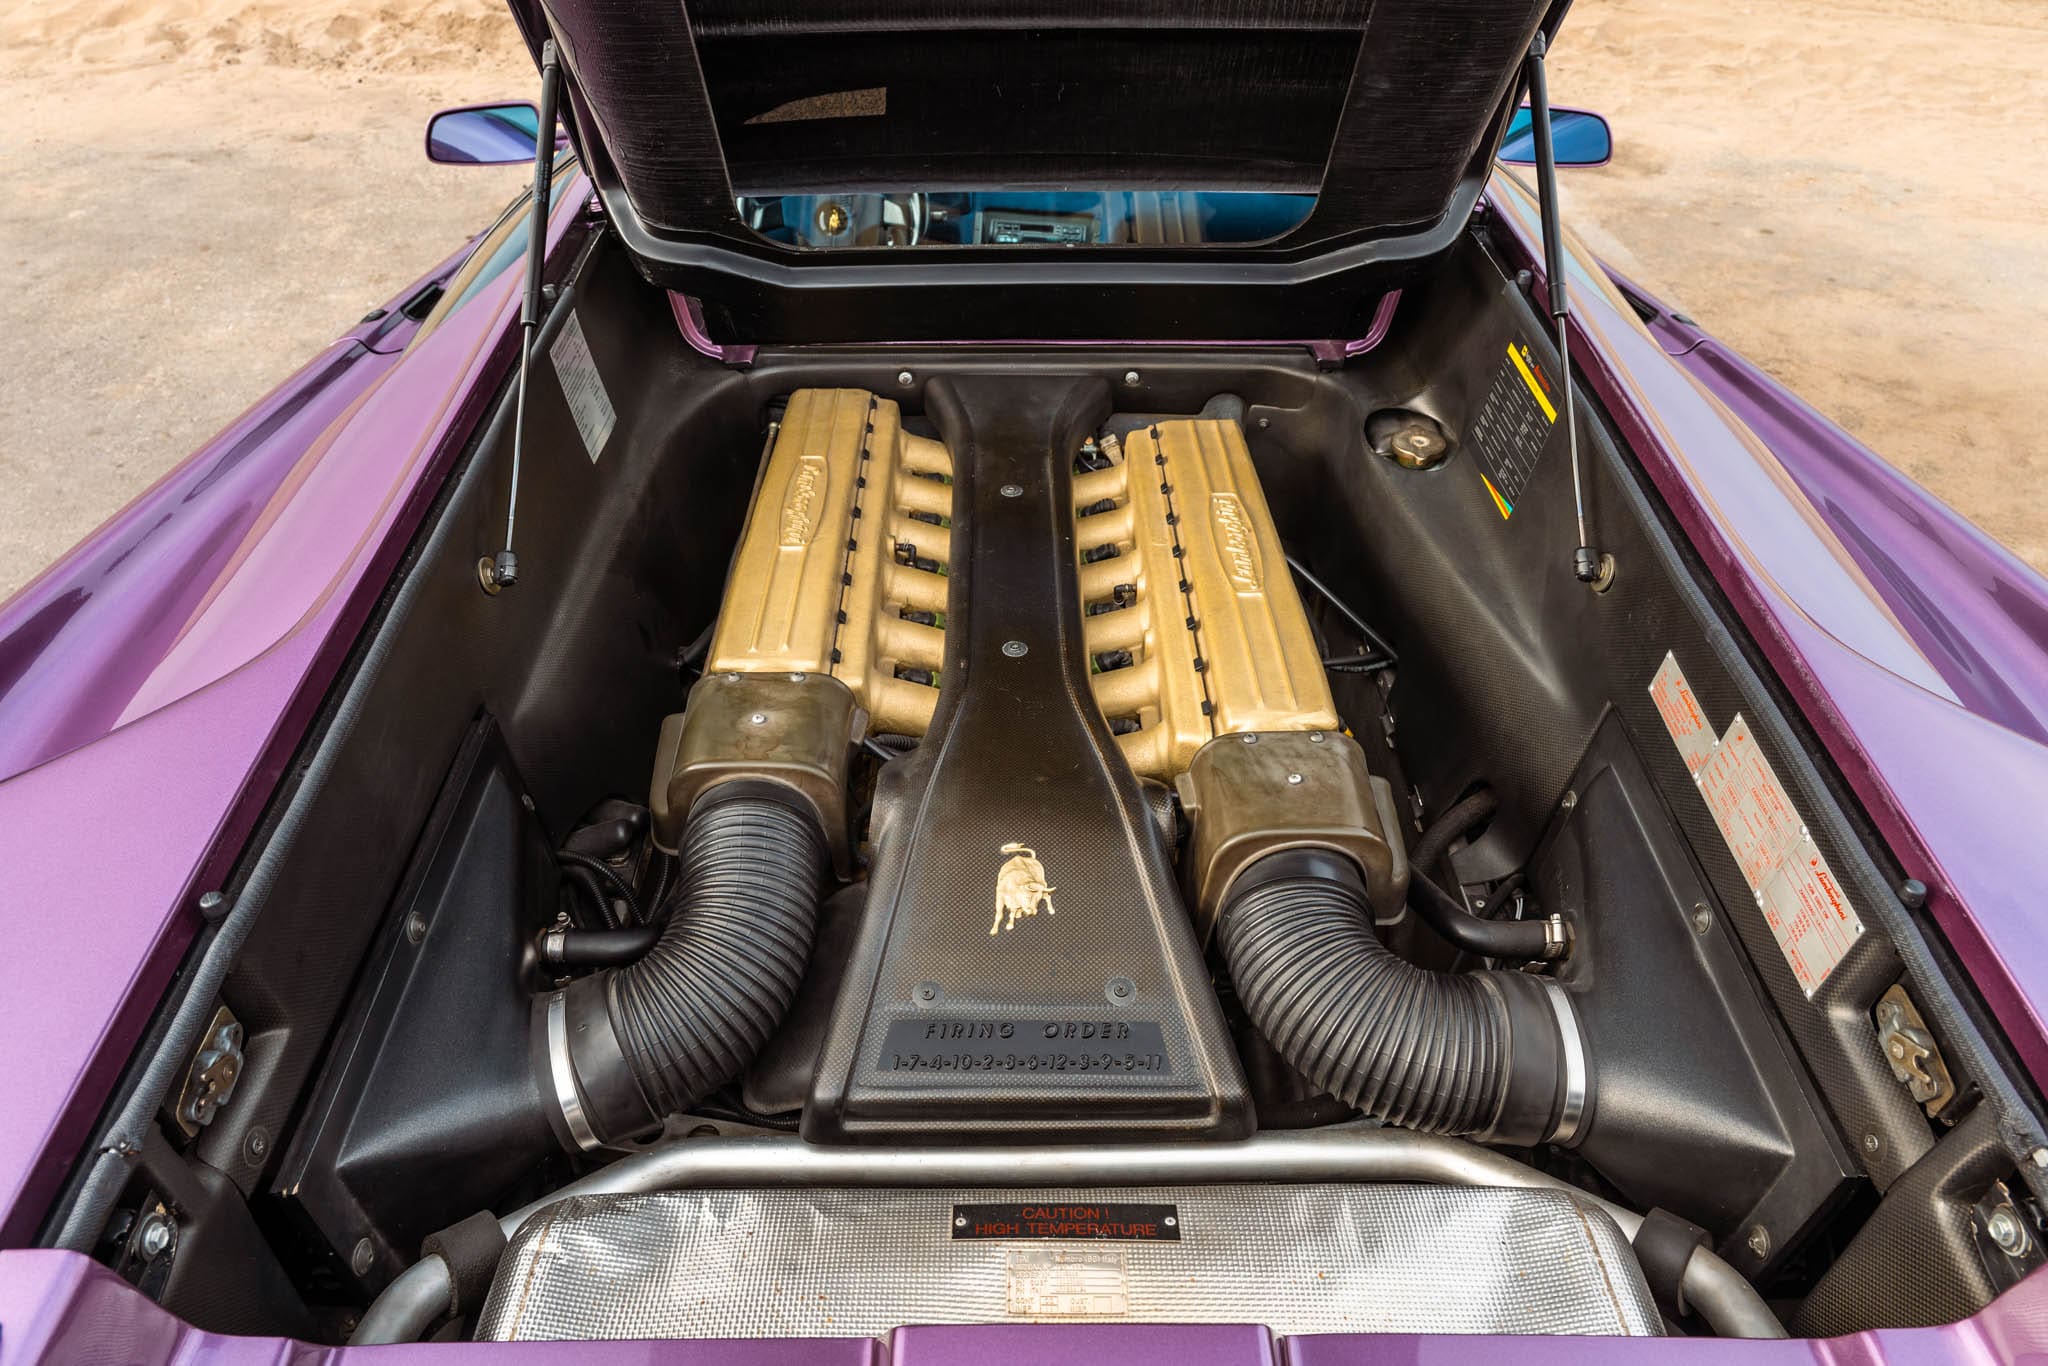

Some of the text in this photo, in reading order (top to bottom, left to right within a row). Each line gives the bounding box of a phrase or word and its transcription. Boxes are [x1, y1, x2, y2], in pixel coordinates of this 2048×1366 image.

[924, 1022, 1130, 1039] FIRING ORDER
[1022, 1206, 1100, 1220] CAUTION
[975, 1222, 1157, 1236] HIGH TEMPERATURE
